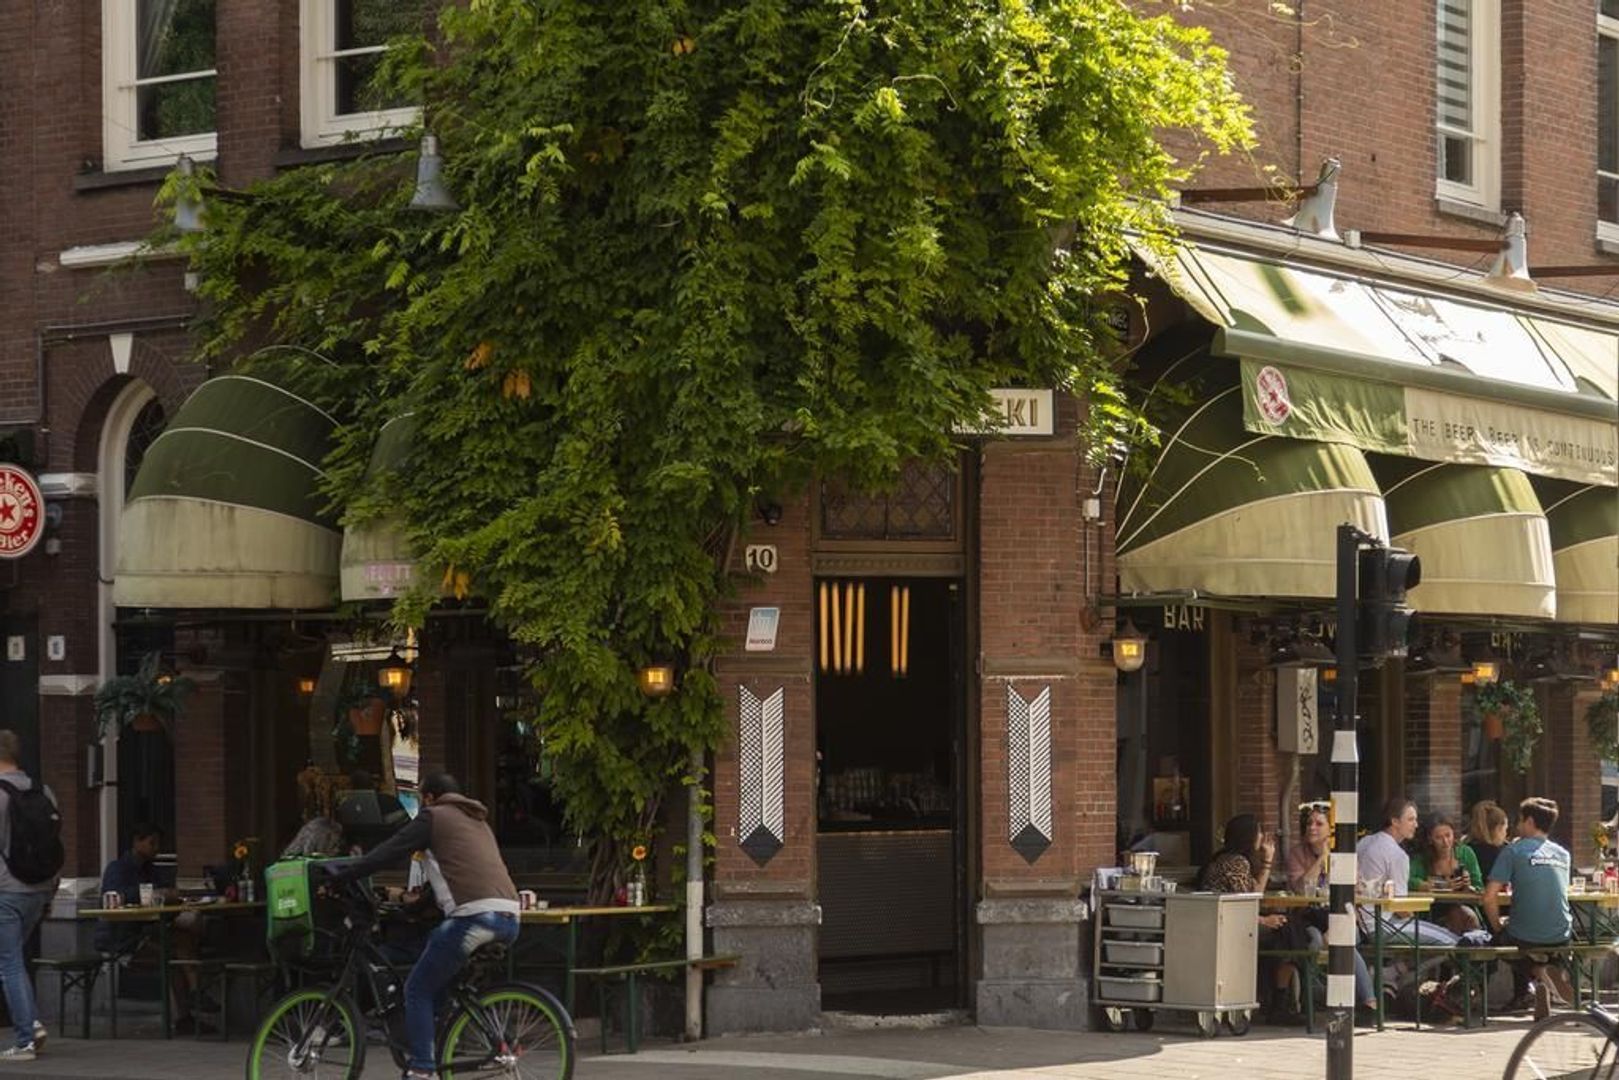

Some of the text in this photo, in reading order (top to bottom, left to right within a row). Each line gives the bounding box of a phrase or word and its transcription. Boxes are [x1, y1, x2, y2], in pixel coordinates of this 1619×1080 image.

[1412, 418, 1435, 437] THE
[1444, 421, 1475, 442] BEER
[748, 548, 773, 568] 10
[1163, 603, 1205, 631] BAR
